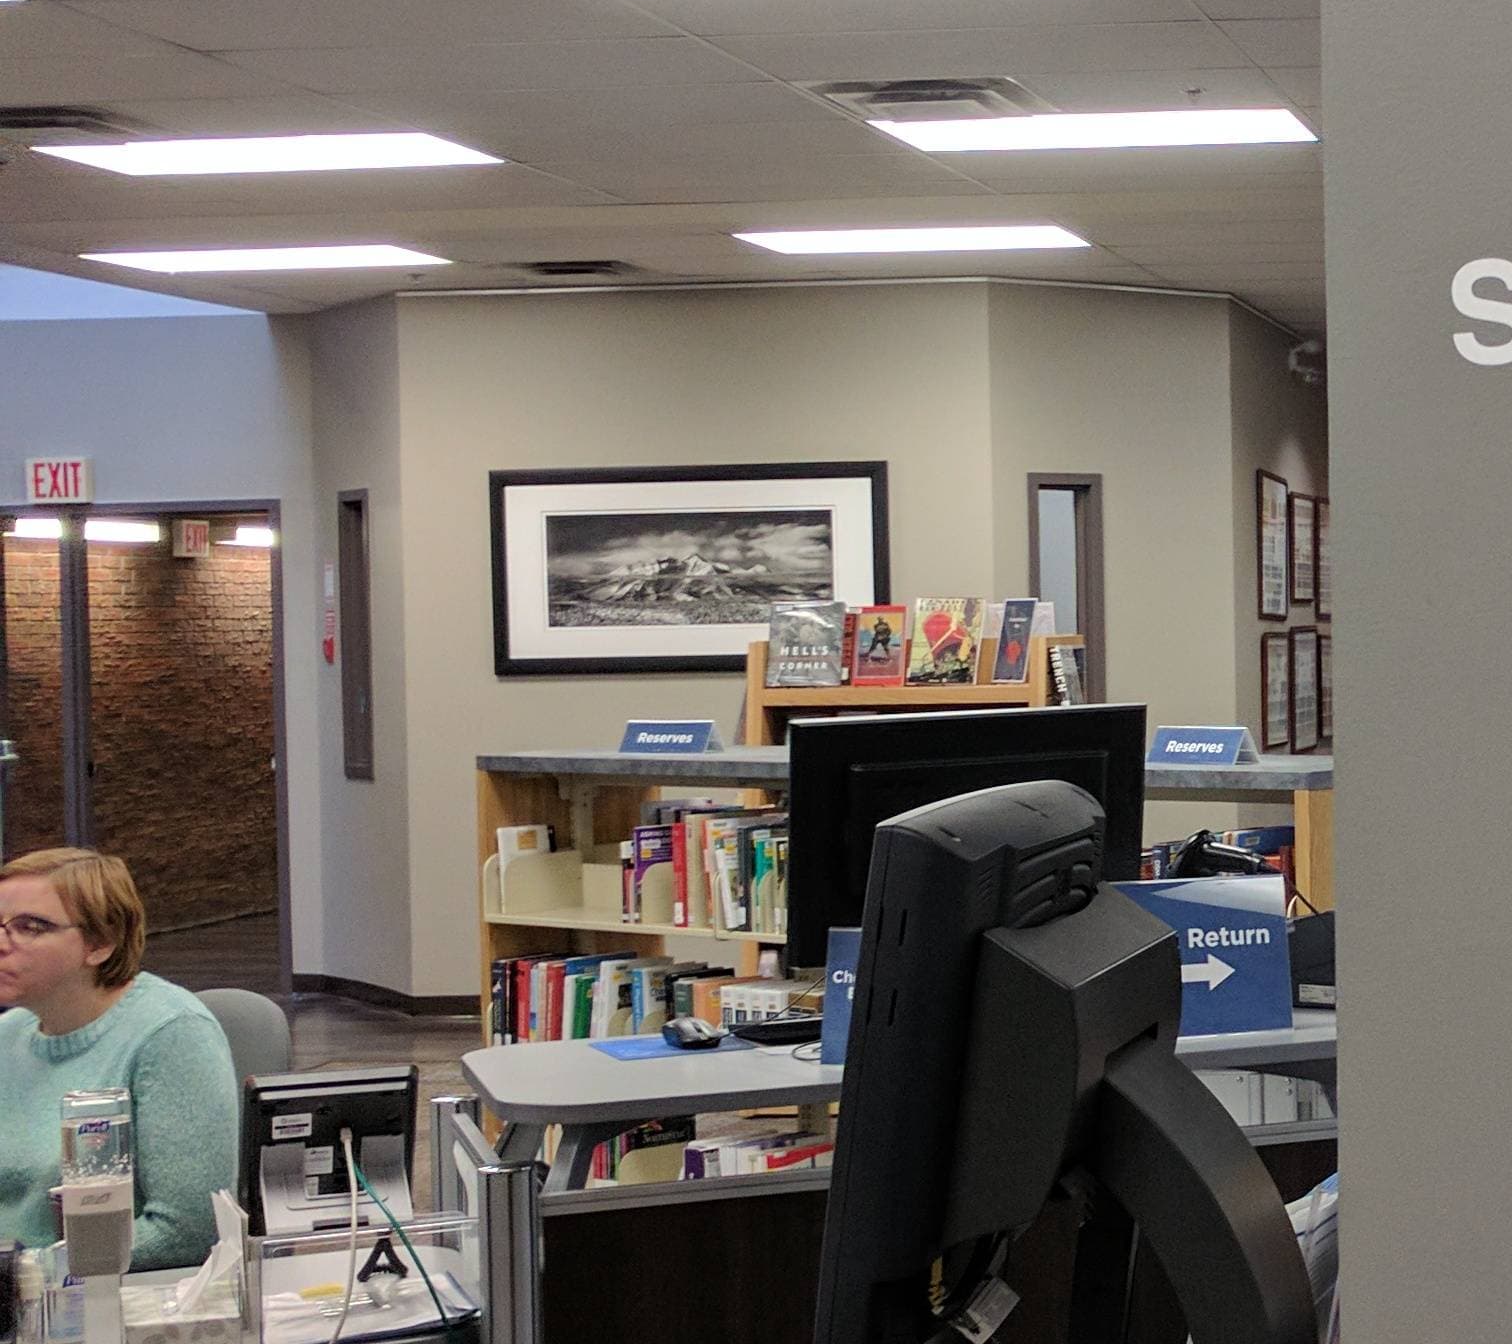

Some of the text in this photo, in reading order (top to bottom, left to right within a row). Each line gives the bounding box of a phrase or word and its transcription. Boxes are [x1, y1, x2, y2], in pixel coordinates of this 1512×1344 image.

[33, 462, 82, 498] EXIT
[184, 523, 209, 553] EXIT
[779, 645, 830, 657] HELL'S
[778, 661, 829, 671] CORNER
[1050, 645, 1067, 693] TRENCH
[637, 732, 694, 744] Reserves
[1165, 740, 1224, 754] Reserves
[1187, 926, 1271, 949] Return
